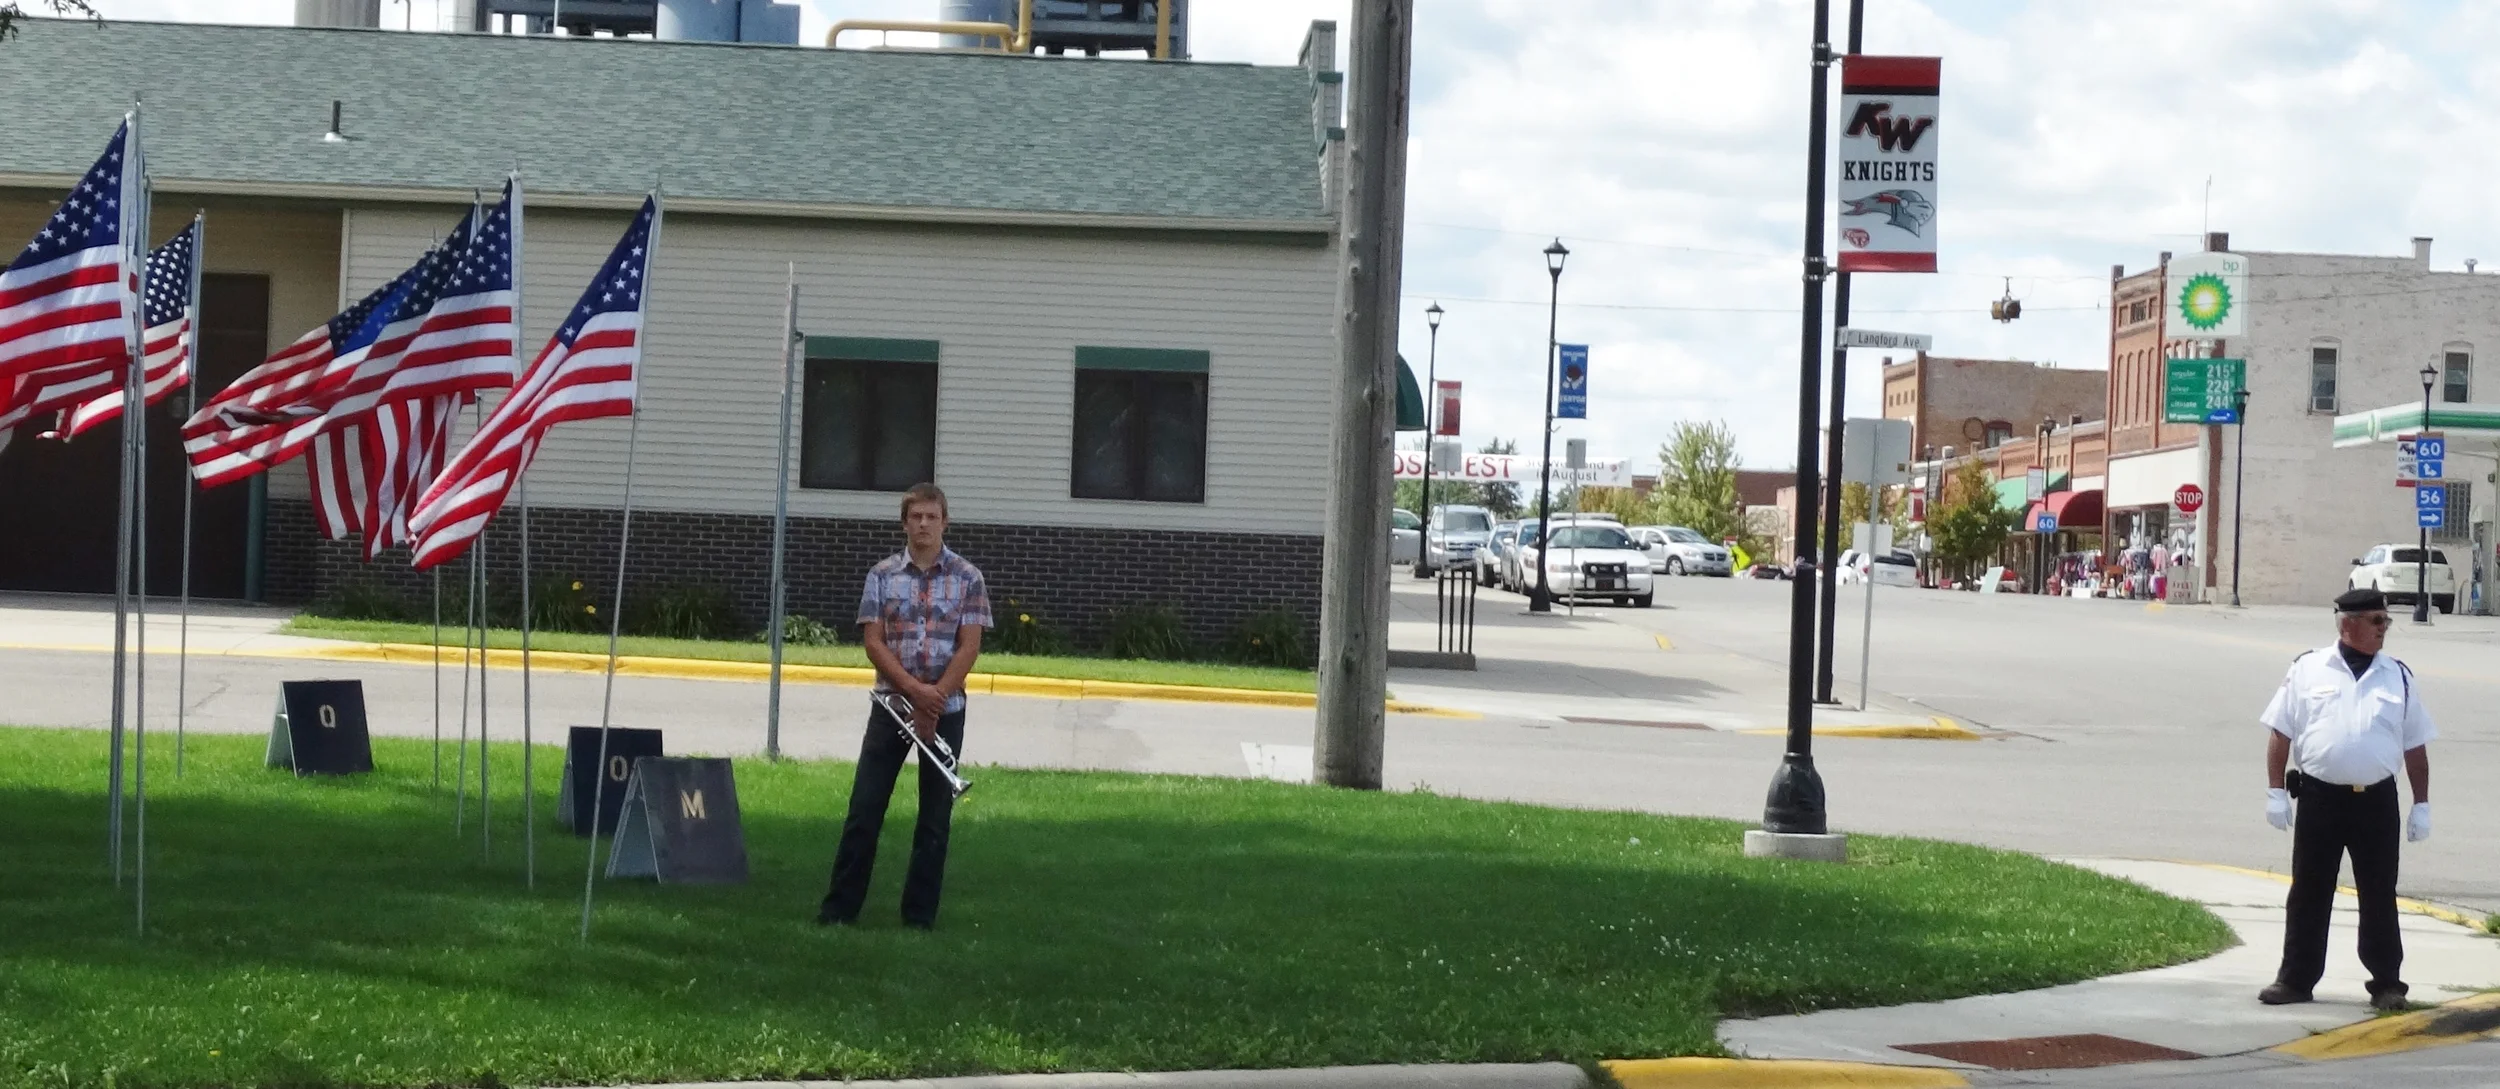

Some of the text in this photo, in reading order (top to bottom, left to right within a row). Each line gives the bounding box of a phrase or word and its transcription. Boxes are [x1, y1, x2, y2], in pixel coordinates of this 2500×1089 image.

[1844, 101, 1936, 153] KW
[1844, 161, 1934, 181] KNIGHTS
[2223, 258, 2239, 273] bp
[1858, 332, 1897, 347] Langford
[2420, 442, 2441, 456] 60
[2175, 491, 2202, 505] STOP
[2420, 490, 2441, 505] 56
[2039, 518, 2054, 529] 60
[681, 788, 705, 820] M
